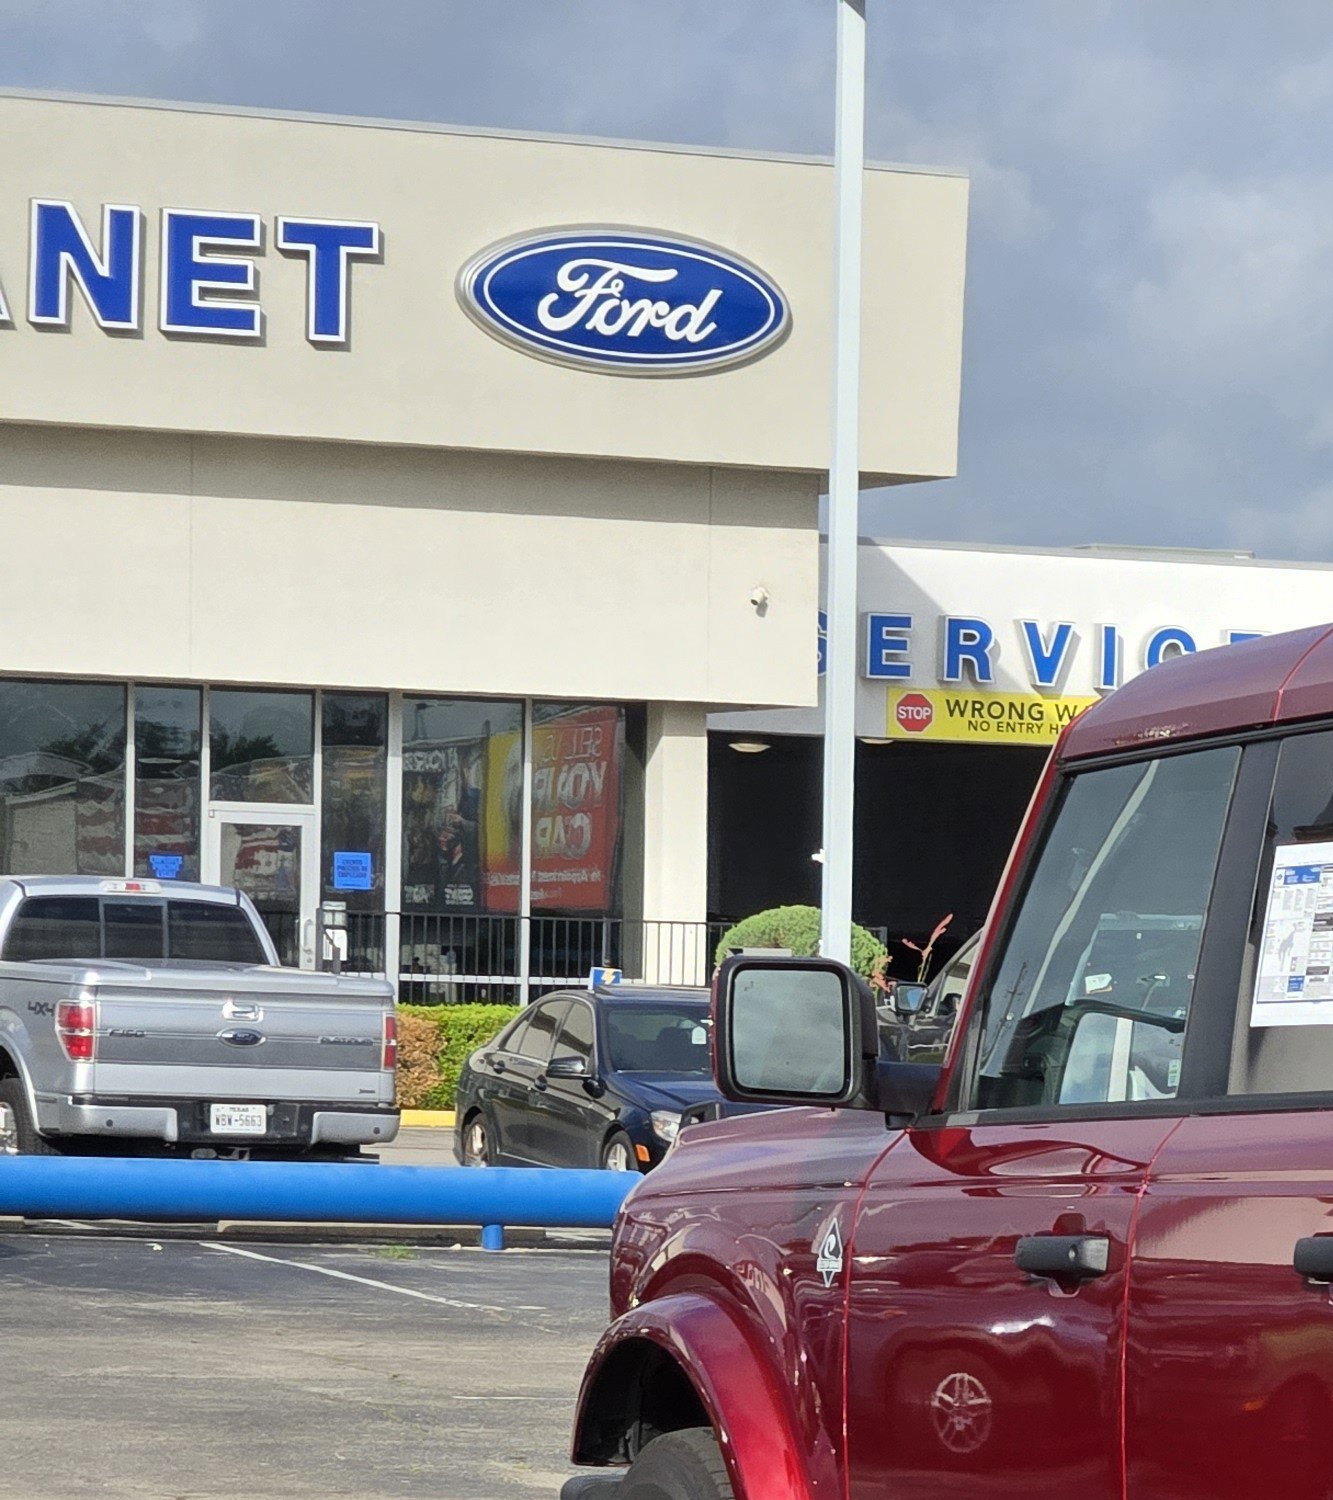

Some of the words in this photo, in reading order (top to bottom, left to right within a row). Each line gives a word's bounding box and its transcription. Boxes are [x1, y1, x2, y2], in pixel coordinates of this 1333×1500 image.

[0, 197, 380, 342] NET
[536, 257, 724, 343] Ford
[817, 608, 1270, 690] ERVIC
[897, 706, 932, 720] STOP
[945, 698, 1044, 721] WRONG
[968, 719, 991, 732] NO
[996, 721, 1044, 734] ENTRY
